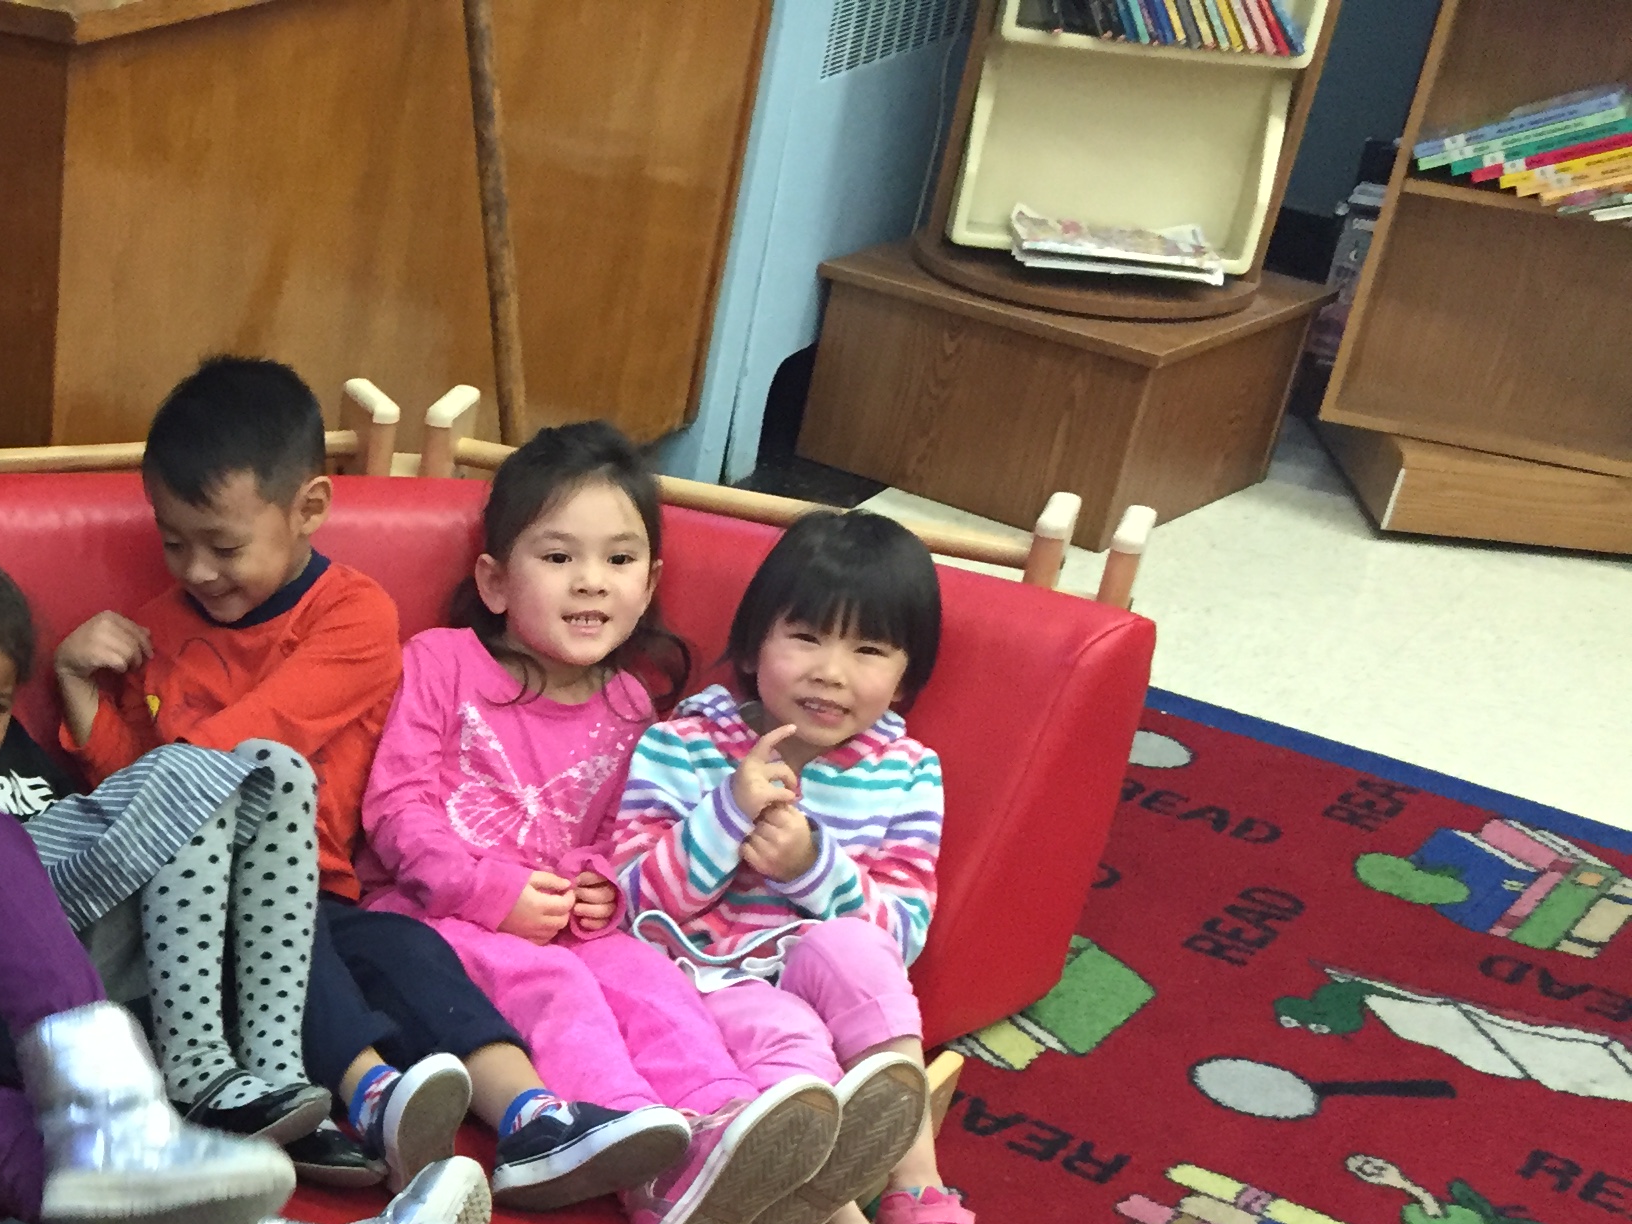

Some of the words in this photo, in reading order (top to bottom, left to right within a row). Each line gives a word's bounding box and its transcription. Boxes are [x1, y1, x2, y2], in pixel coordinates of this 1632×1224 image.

[1182, 887, 1305, 968] READ
[950, 1090, 1132, 1184] REA
[1515, 1149, 1632, 1221] RE
